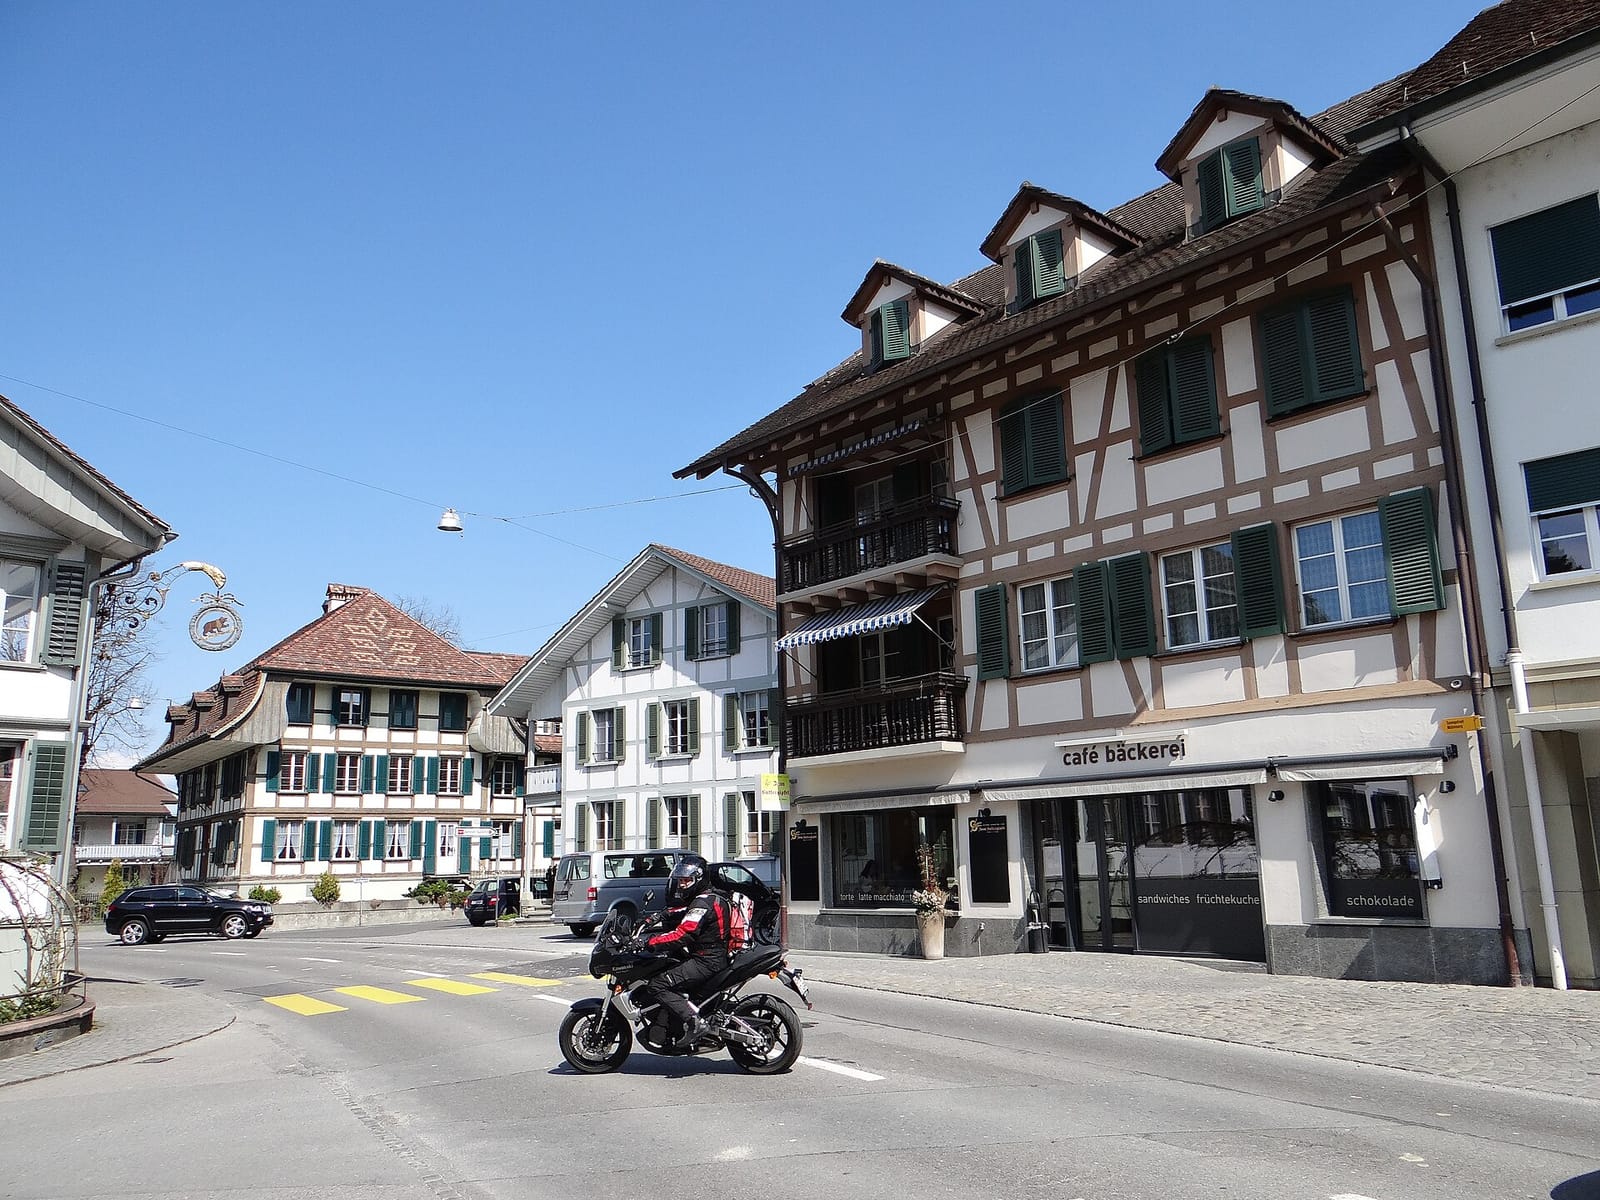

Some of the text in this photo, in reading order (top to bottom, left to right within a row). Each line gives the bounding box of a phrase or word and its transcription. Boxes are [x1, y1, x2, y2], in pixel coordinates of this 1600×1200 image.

[1062, 739, 1186, 766] café bäckerei
[840, 893, 855, 902] torte
[858, 892, 873, 902] latte
[873, 892, 905, 902] macchiato
[1137, 893, 1191, 904] sandwiches
[1346, 894, 1415, 907] schokolade
